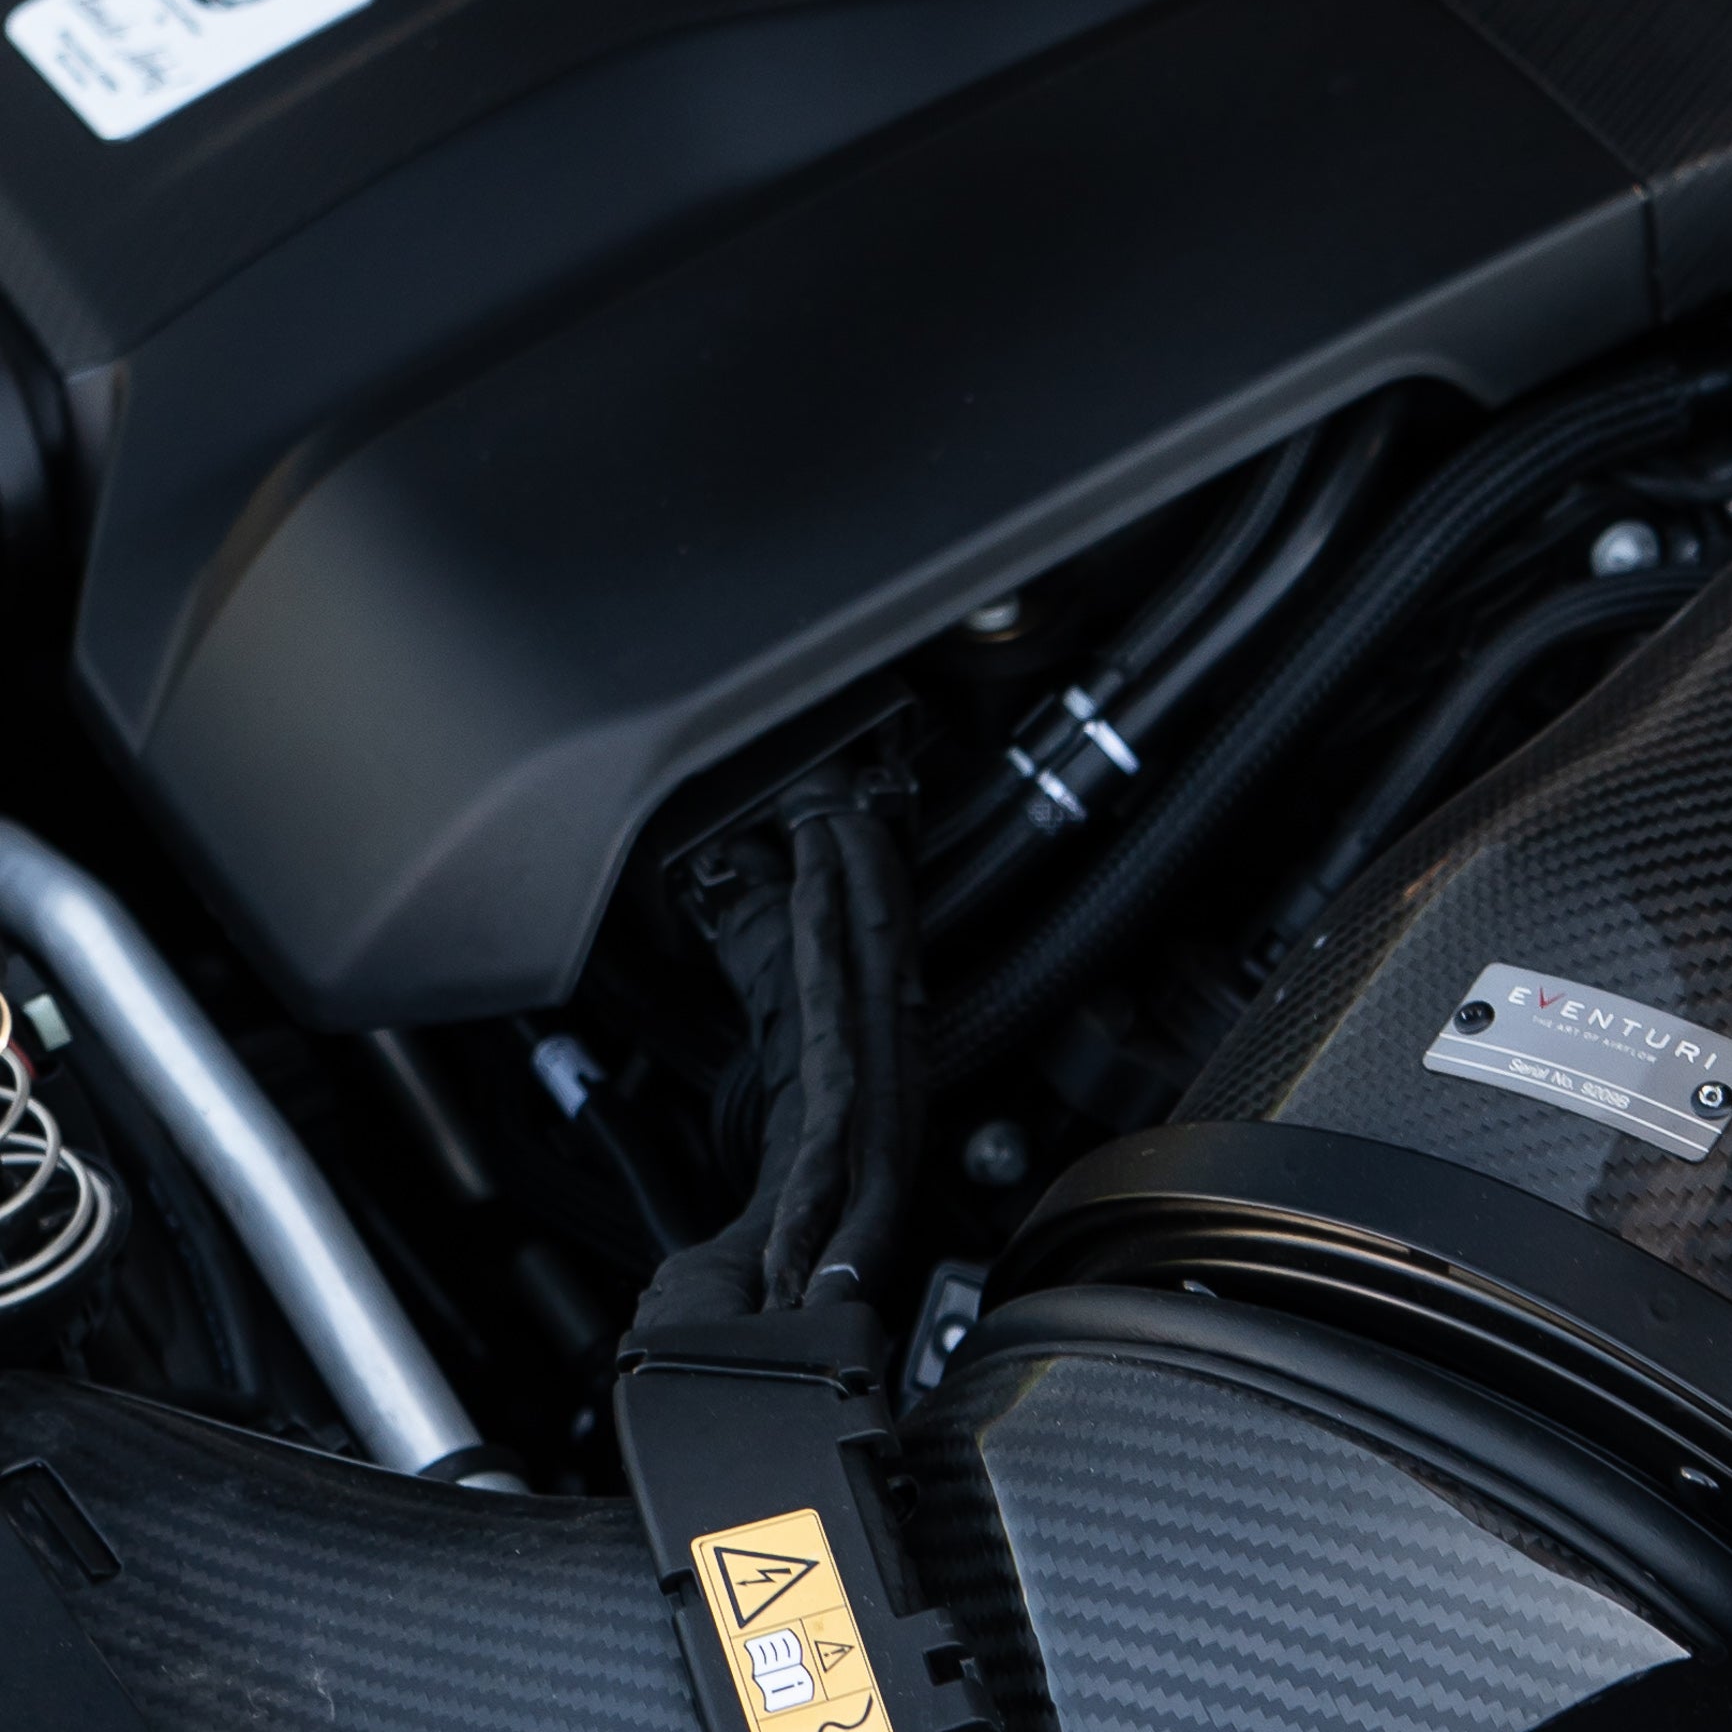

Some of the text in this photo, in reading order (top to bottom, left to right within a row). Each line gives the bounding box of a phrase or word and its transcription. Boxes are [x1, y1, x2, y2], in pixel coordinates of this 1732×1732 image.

[1508, 985, 1717, 1070] EVENTURI
[1556, 1024, 1580, 1036] ART
[1583, 1031, 1599, 1041] OF
[1551, 1070, 1574, 1091] No.
